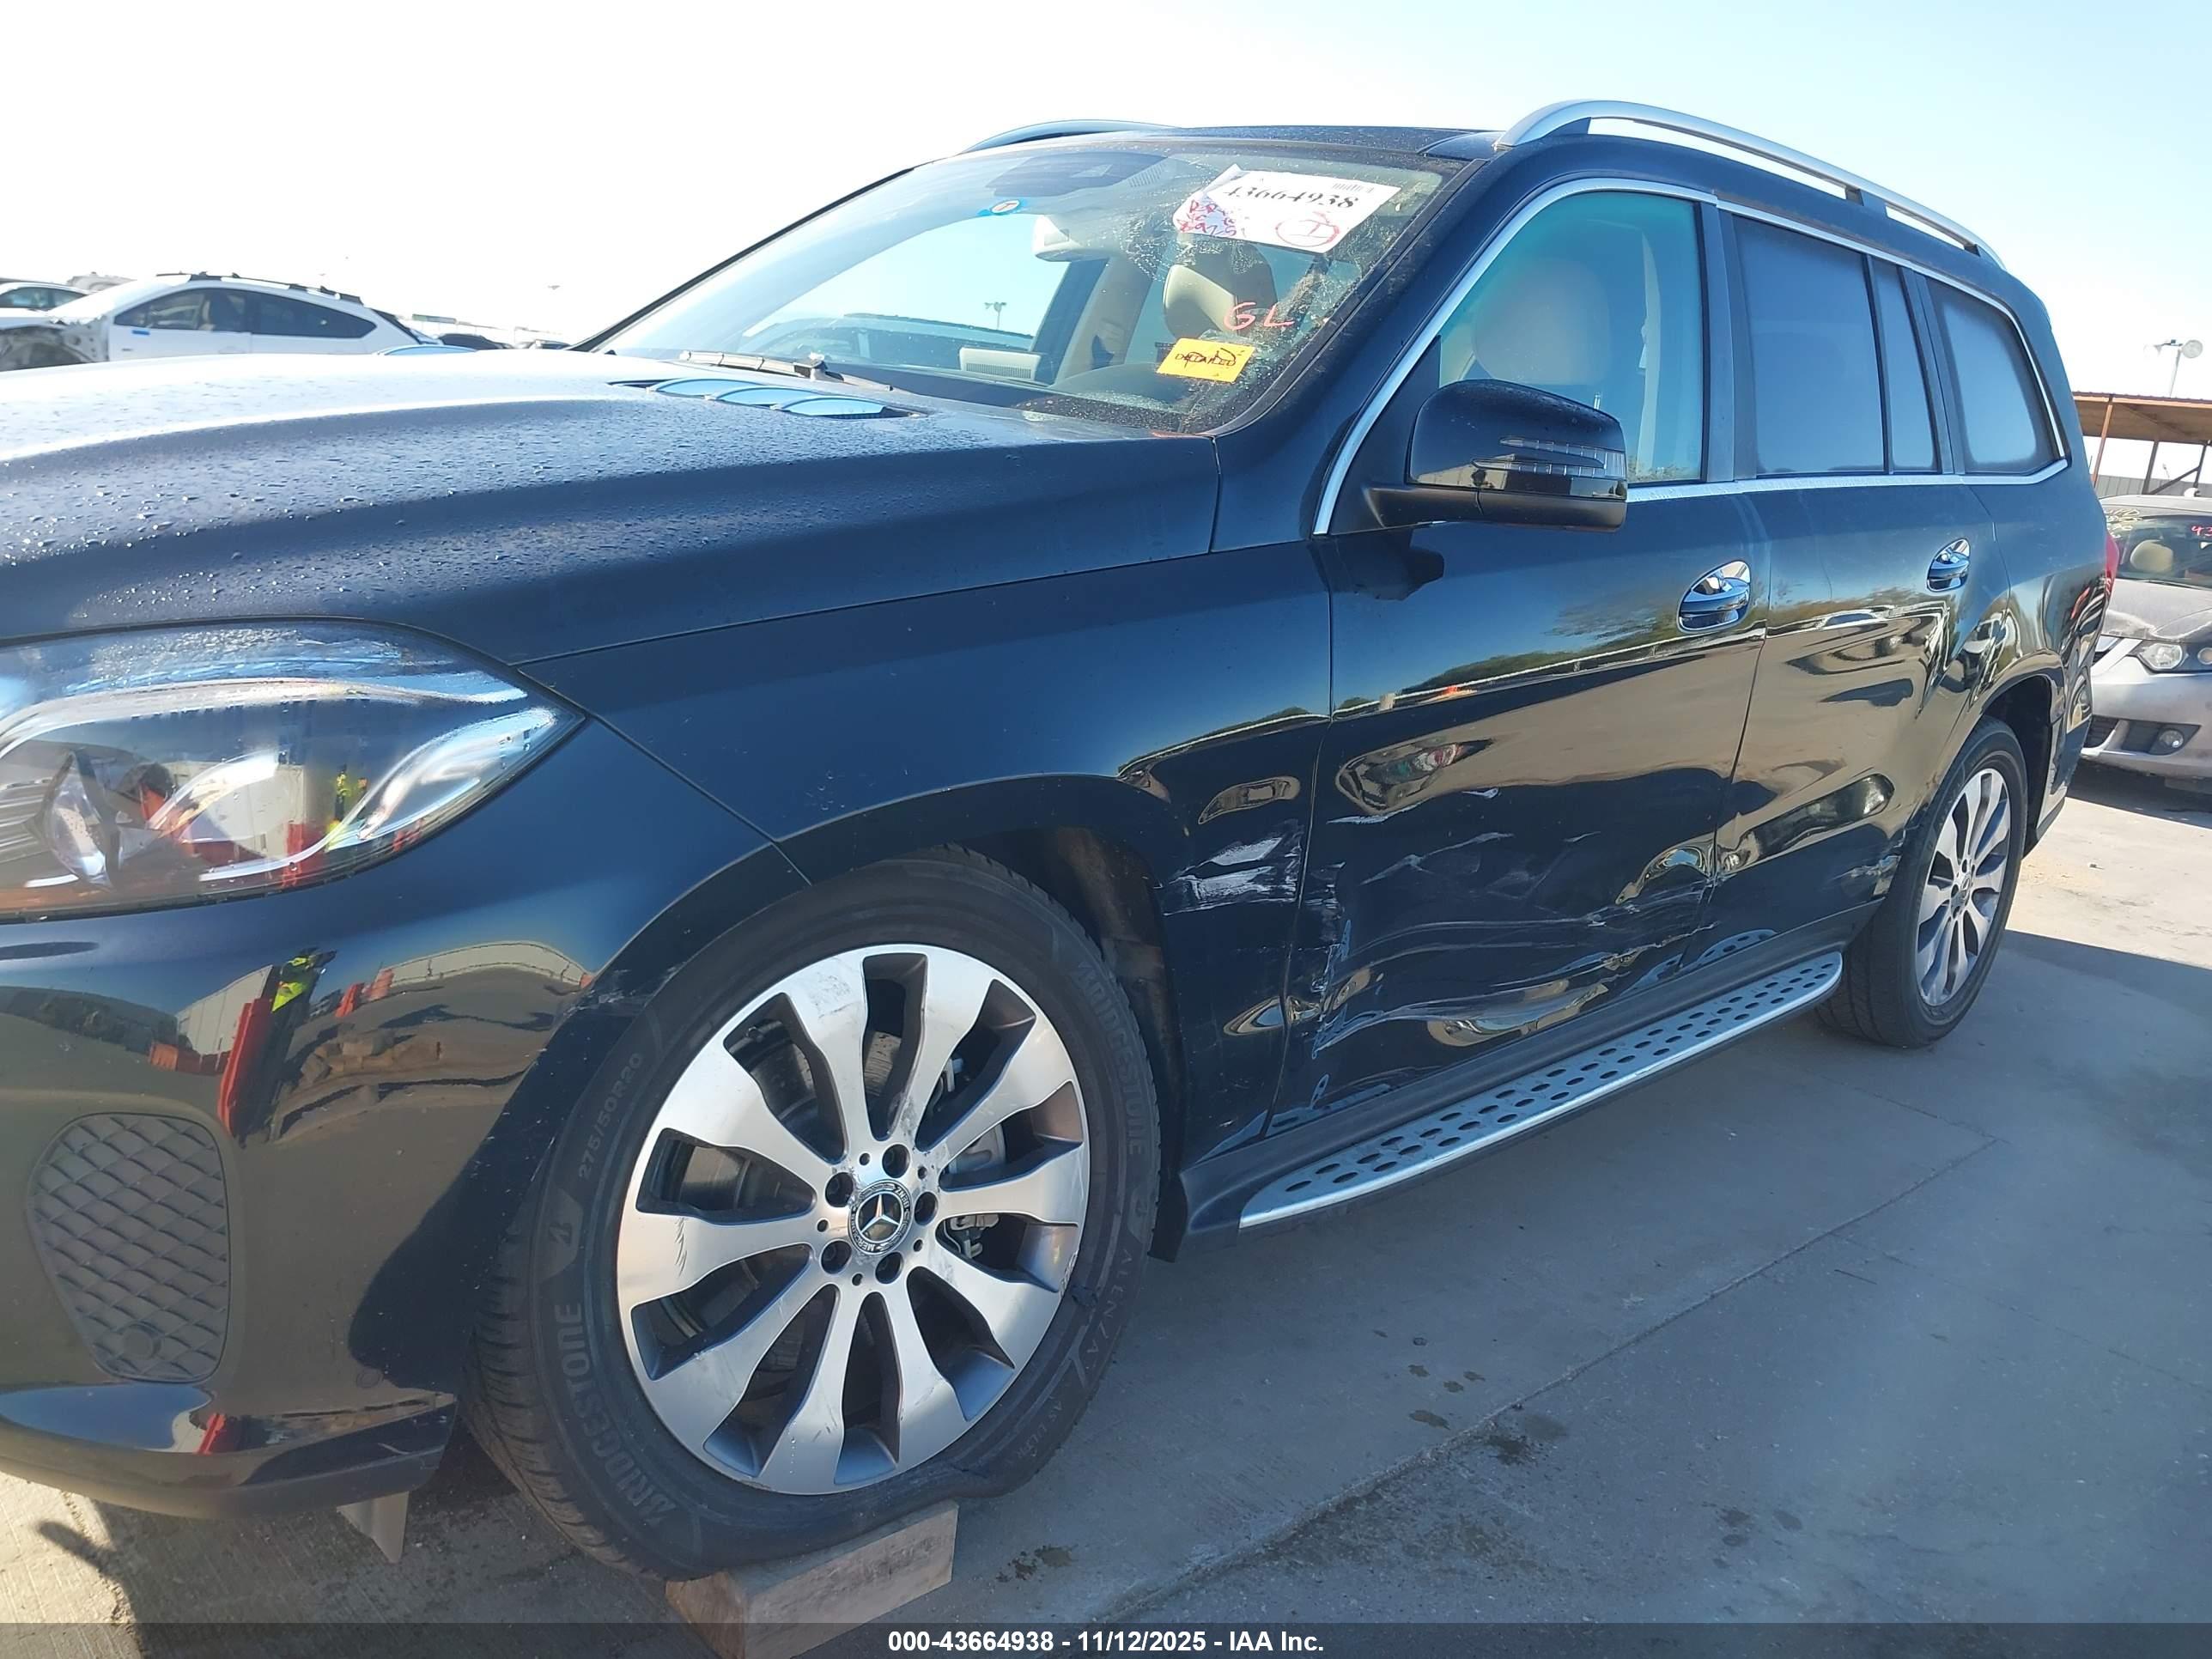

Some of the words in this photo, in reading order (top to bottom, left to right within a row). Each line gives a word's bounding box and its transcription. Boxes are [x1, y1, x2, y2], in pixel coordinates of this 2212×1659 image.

[578, 1051, 645, 1181] 275/50R20
[1086, 1248, 1133, 1354] ALENZA
[555, 1304, 677, 1528] BRIDGESTONE
